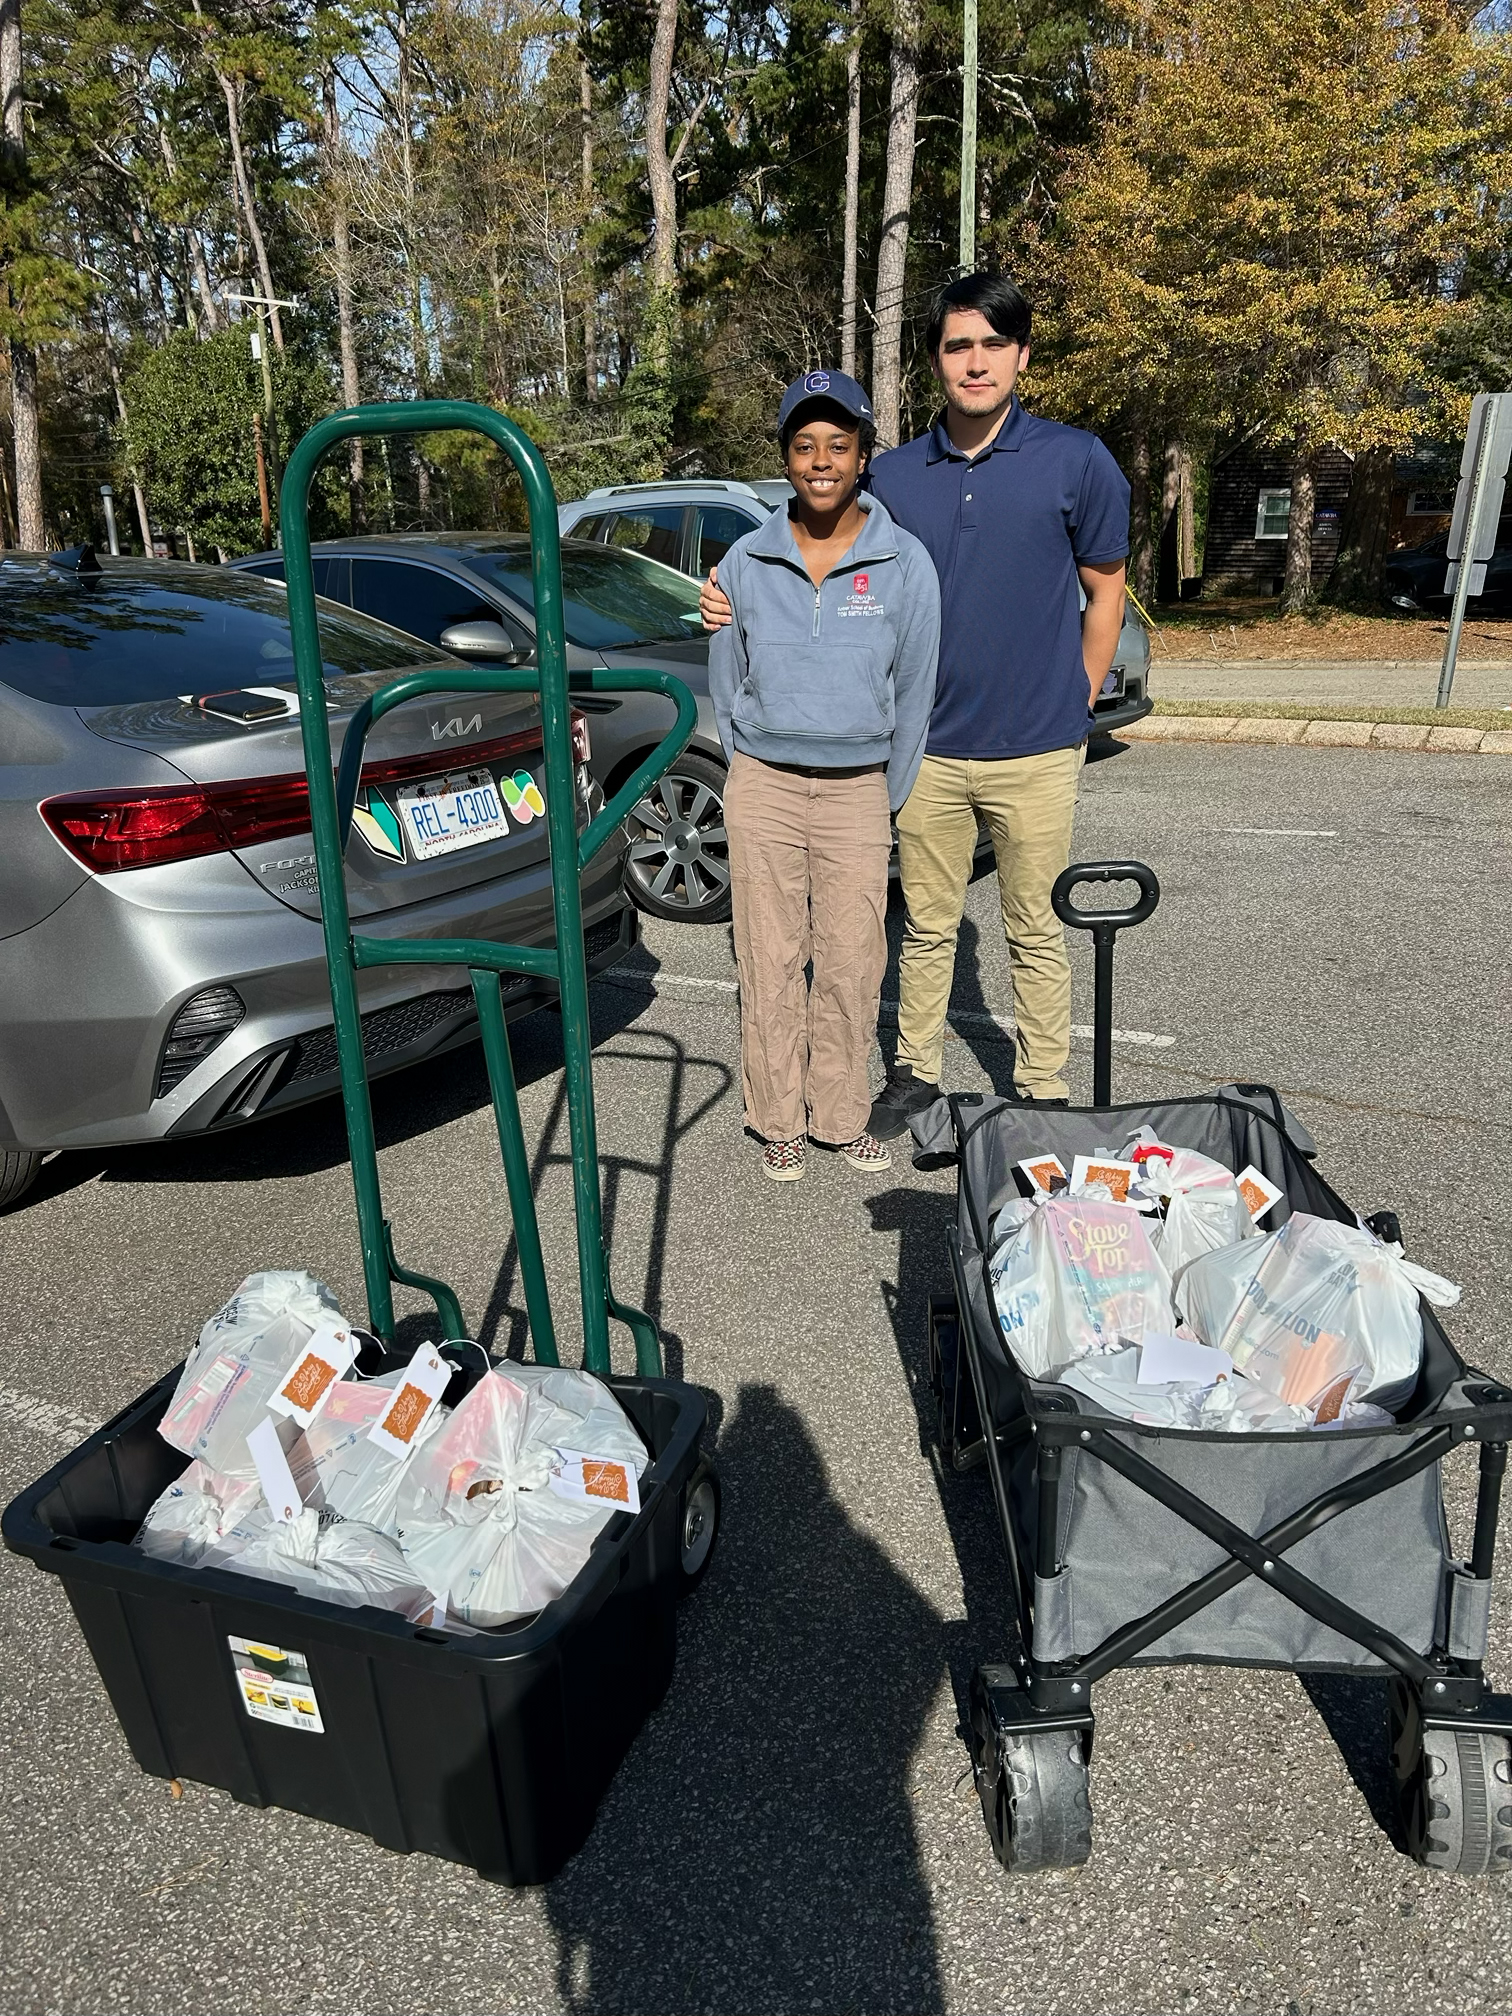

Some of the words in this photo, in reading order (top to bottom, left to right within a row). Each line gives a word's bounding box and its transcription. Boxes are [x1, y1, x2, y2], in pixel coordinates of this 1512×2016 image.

[804, 371, 830, 394] C
[431, 713, 482, 741] KIA
[410, 788, 500, 841] REL-4300
[260, 855, 317, 874] FORT
[294, 867, 318, 879] CAPIT
[280, 876, 320, 893] JACKSO
[1068, 1217, 1129, 1261] Stove
[1091, 1245, 1131, 1273] Top
